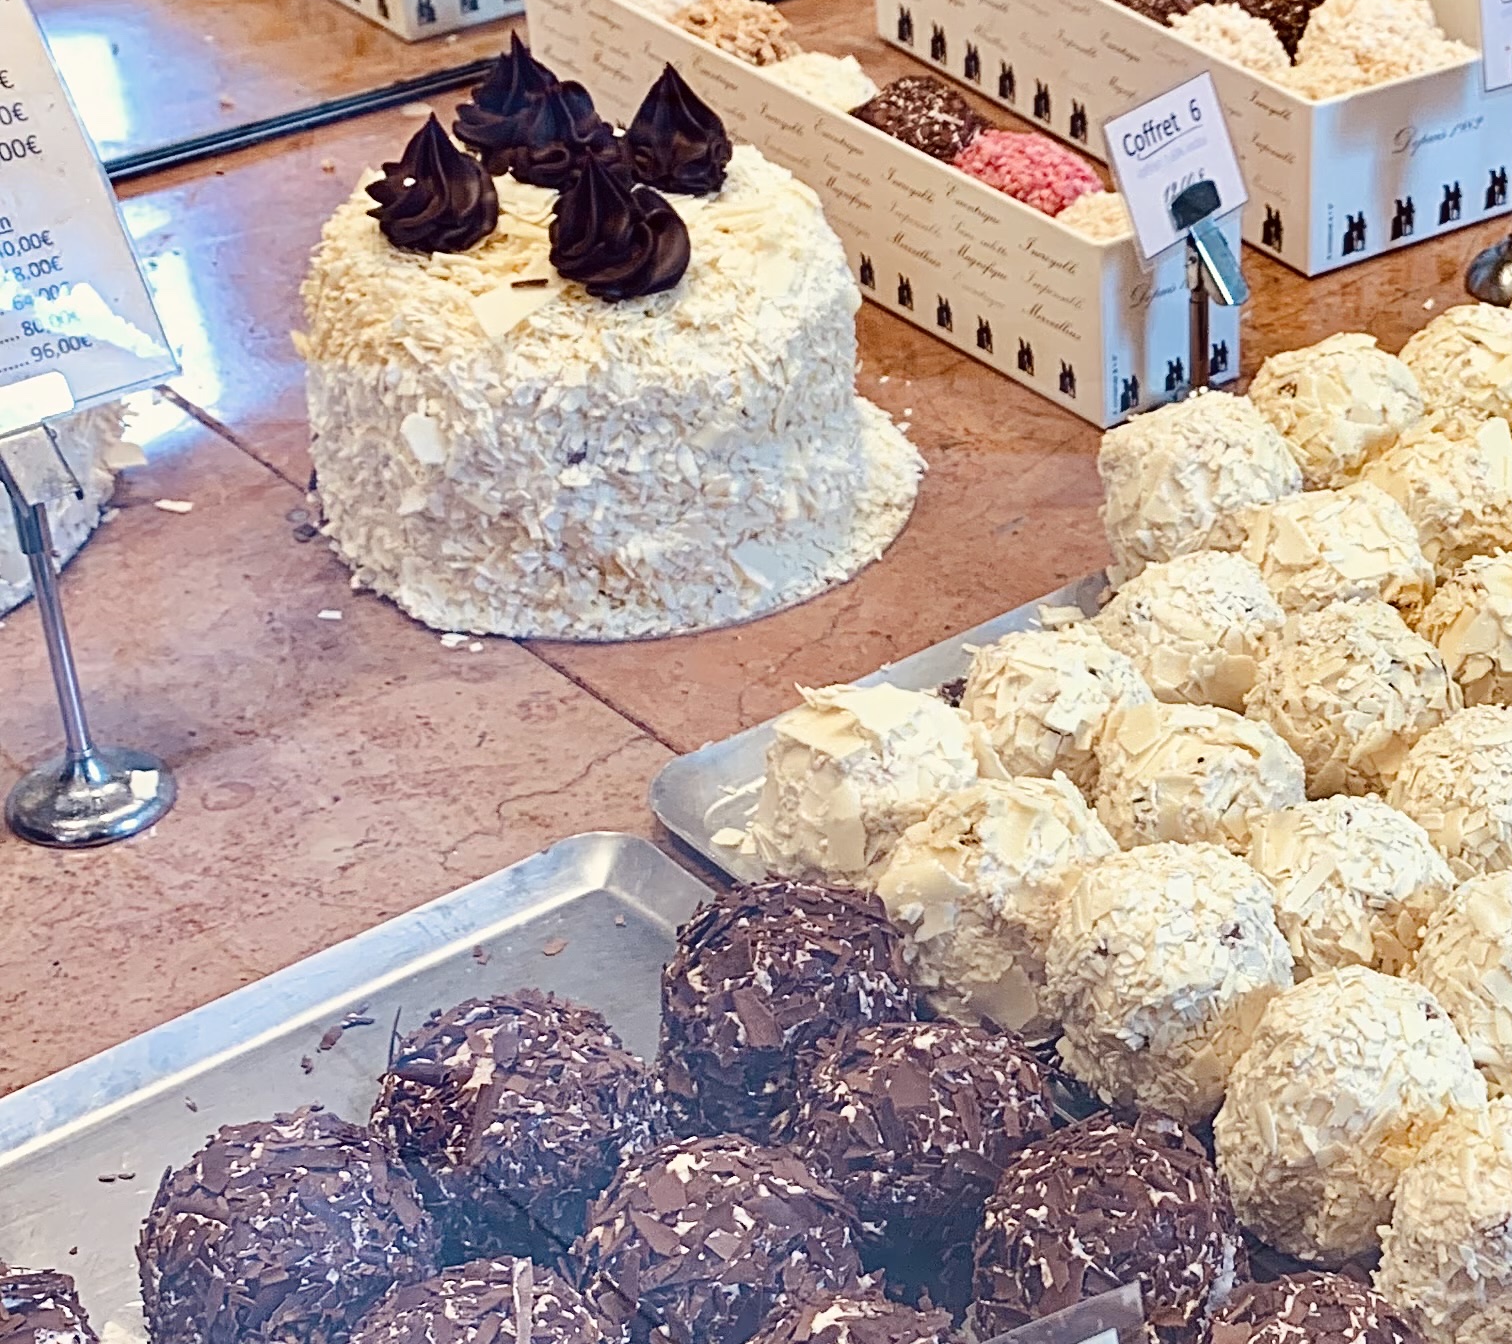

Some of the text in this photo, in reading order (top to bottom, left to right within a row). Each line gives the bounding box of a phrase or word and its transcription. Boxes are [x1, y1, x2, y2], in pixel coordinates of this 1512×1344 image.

[1123, 98, 1201, 156] Coffret 6
[0, 229, 55, 258] 0,00€
[30, 335, 93, 363] 96,00€
